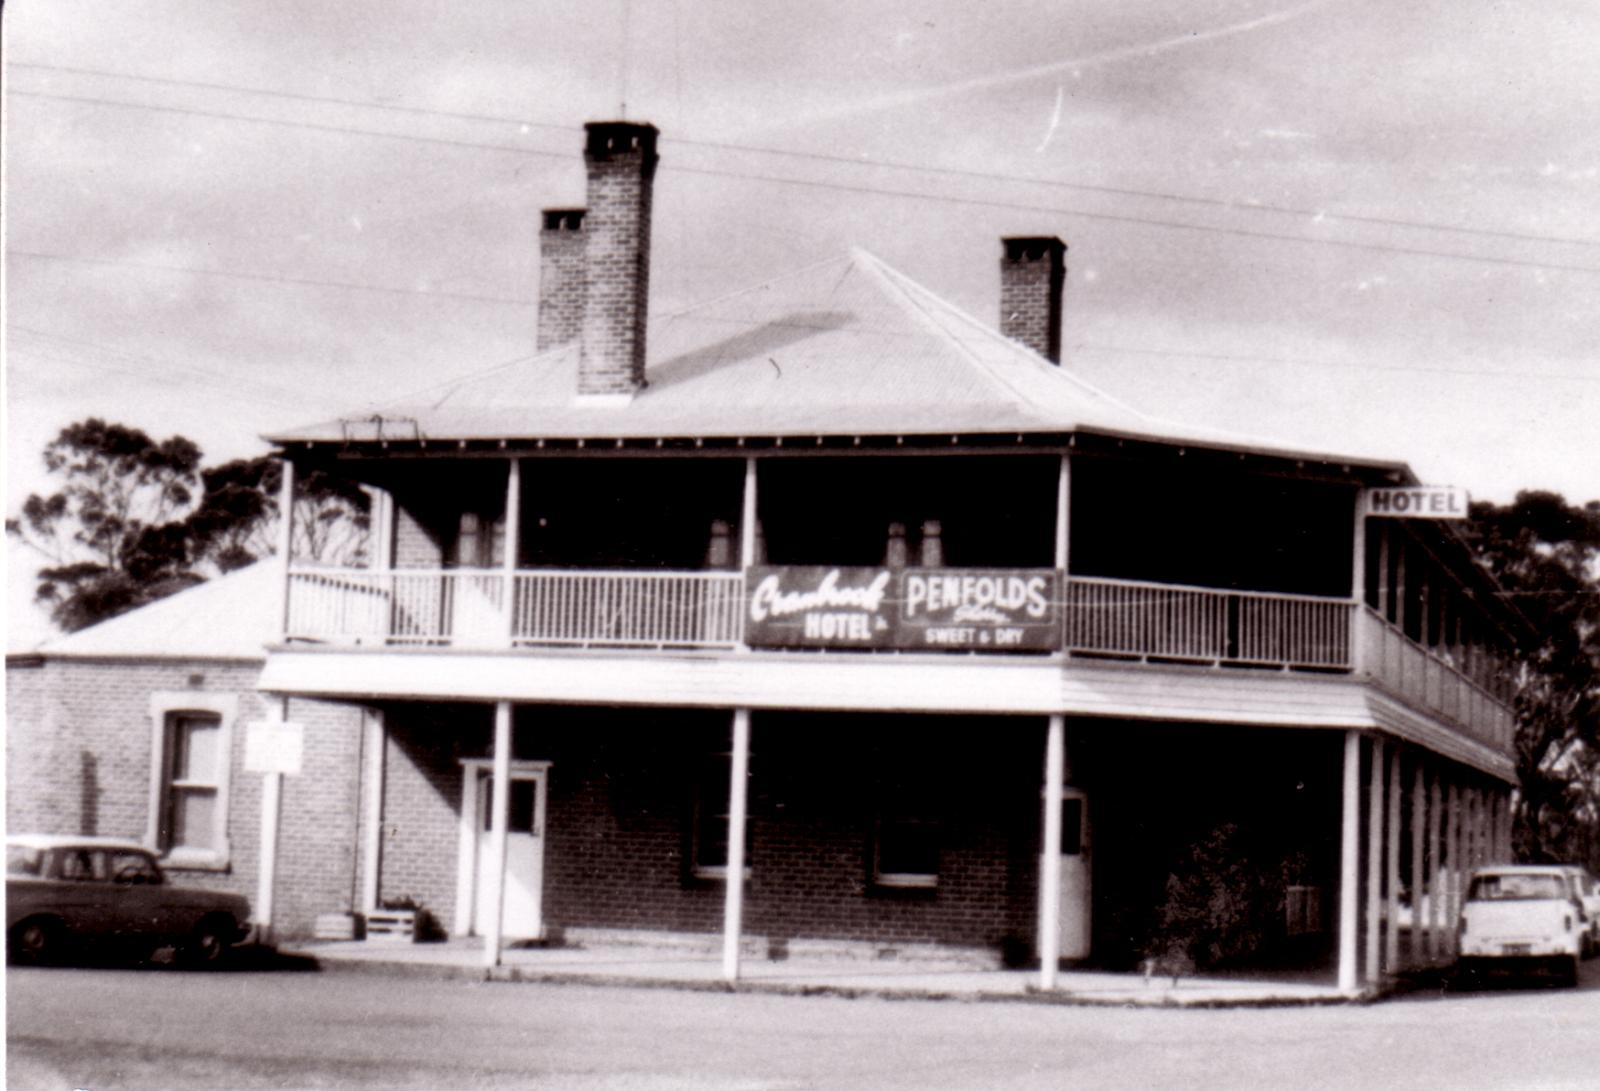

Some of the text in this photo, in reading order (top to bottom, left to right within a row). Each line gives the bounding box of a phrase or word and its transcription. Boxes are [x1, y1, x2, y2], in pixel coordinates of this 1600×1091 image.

[1372, 490, 1461, 513] HOTEL
[907, 575, 1047, 618] PENFOLDS
[804, 612, 872, 640] HOTEL
[925, 627, 976, 644] SWEET
[994, 627, 1024, 644] DRY
